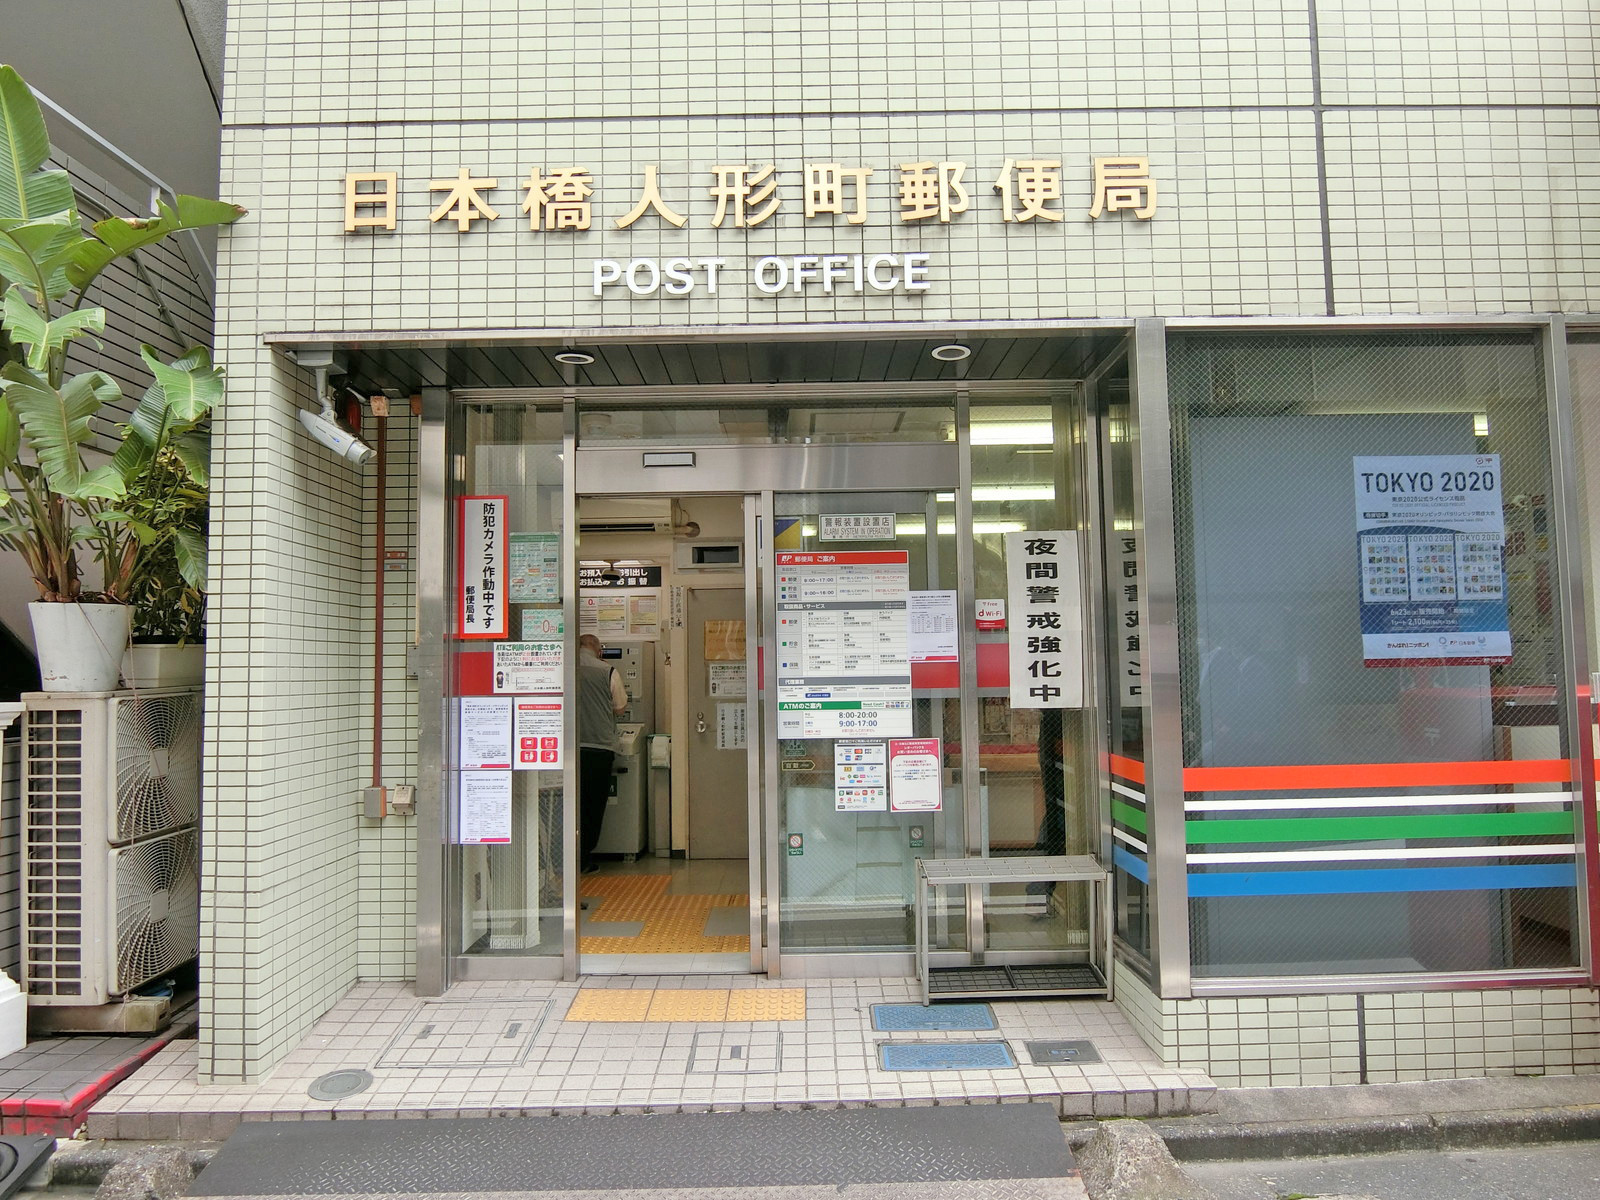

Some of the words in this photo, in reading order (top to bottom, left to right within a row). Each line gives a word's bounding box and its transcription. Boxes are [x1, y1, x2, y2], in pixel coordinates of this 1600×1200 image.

[343, 156, 1158, 234] 日本橋人形町郵便局
[593, 257, 725, 298] POST
[753, 252, 930, 296] OFFICE
[1361, 472, 1434, 493] TOKYO
[1440, 470, 1494, 492] 2020
[824, 527, 840, 535] ALARM
[841, 527, 859, 535] SYSTEM
[867, 526, 891, 534] OPERATION
[825, 517, 890, 527] 警報装置設置店
[1408, 535, 1433, 543] TOKYO
[483, 502, 495, 629] 防犯カメラ作動中です
[466, 586, 475, 623] 郵便局長
[1023, 538, 1062, 702] 夜間警戒強化中
